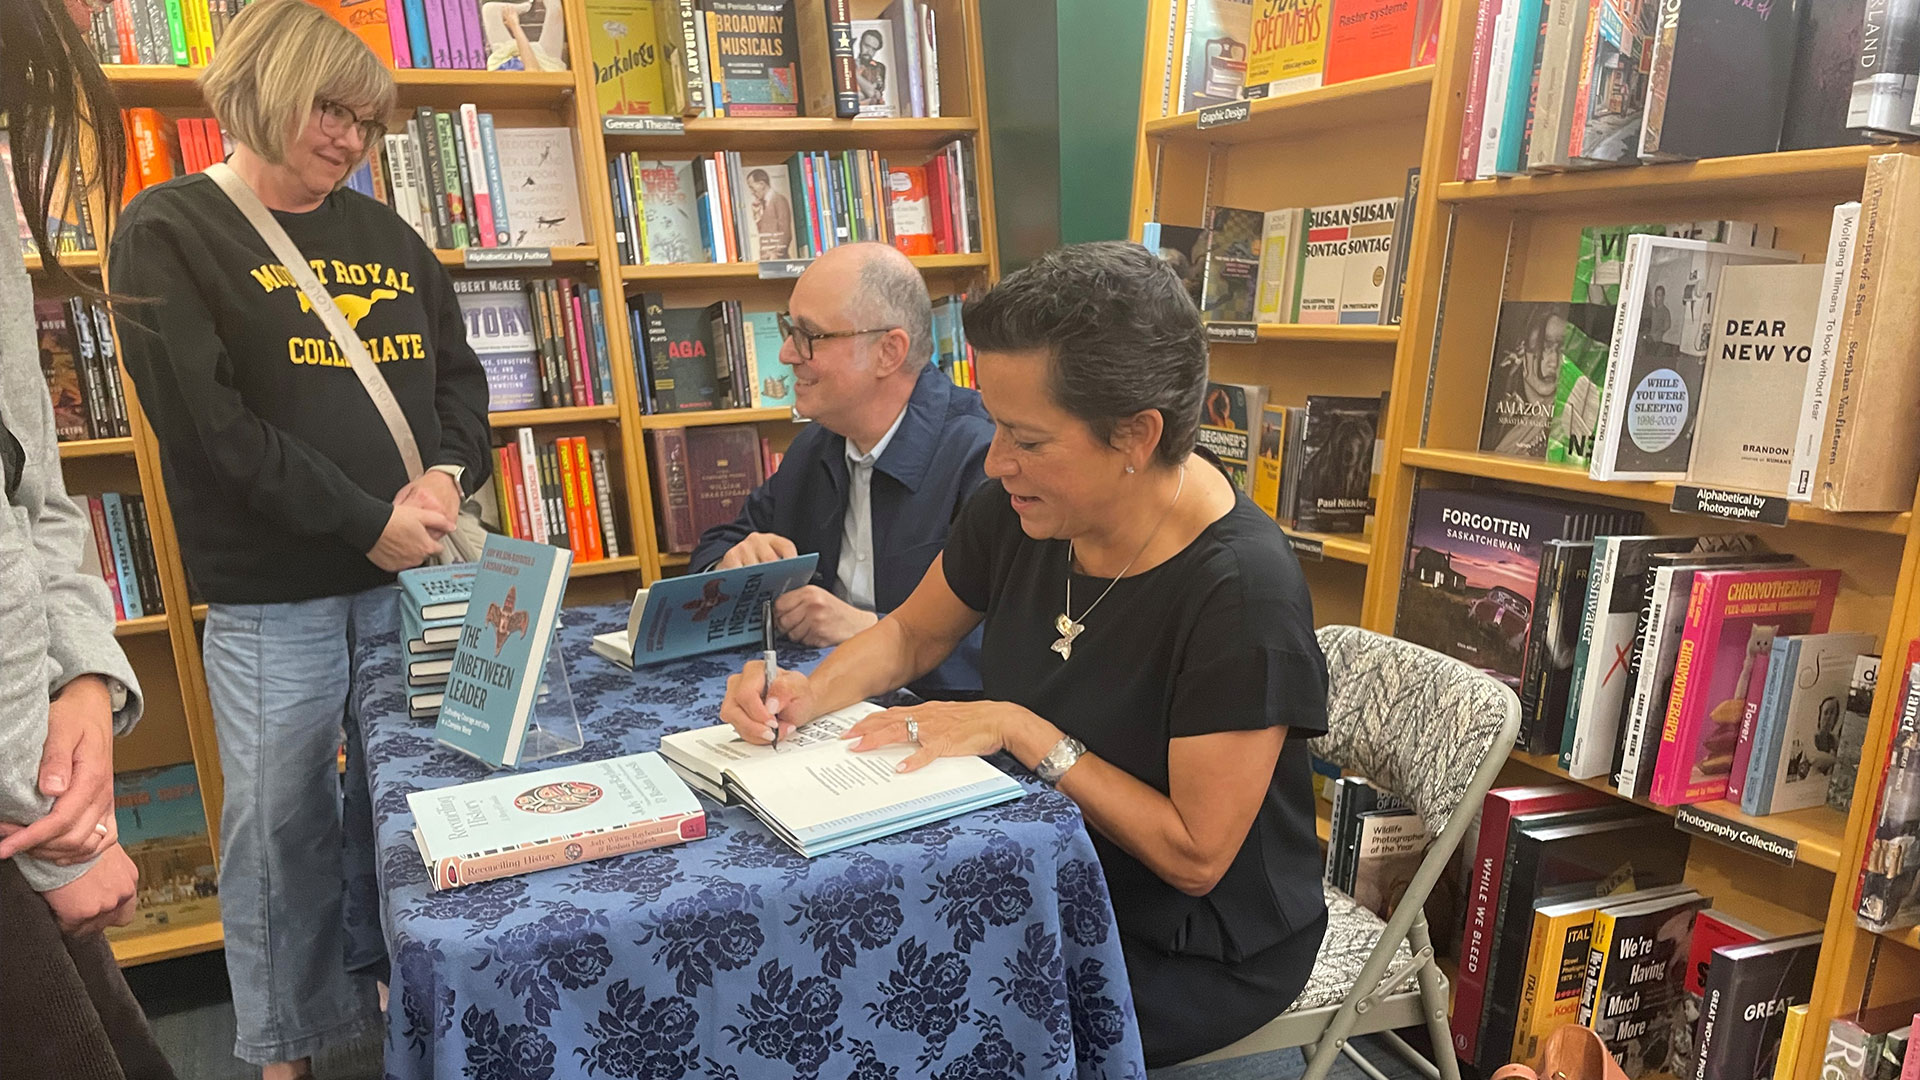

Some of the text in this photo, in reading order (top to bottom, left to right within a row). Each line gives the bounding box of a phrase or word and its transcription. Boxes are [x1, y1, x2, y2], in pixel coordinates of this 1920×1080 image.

[715, 14, 784, 34] BROADWAY
[1338, 13, 1369, 28] Raster
[1664, 0, 1680, 29] ON
[1252, 4, 1323, 55] SPECIMENS
[1860, 0, 1887, 68] RLAND
[683, 21, 699, 74] LIBRARY
[720, 37, 783, 56] MUSICALS
[606, 119, 681, 131] General Theatre
[1201, 106, 1248, 123] Graphic Design
[1309, 208, 1350, 229] SUSAN
[1351, 202, 1397, 224] SUSAN
[1304, 242, 1346, 258] SONTAG
[1347, 237, 1391, 255] SONTAG
[469, 253, 513, 262] Alphabetical
[513, 253, 523, 262] by
[786, 263, 806, 274] Plays
[250, 259, 416, 295] MOUT ROYAL
[453, 281, 486, 293] OBERT
[1855, 294, 1866, 316] Sea
[1725, 319, 1787, 337] DEAR
[1811, 216, 1853, 421] Wolfgang Tillmans To look without fear
[1206, 327, 1236, 339] Photography
[288, 334, 426, 369] COLLIATE
[668, 340, 706, 359] AGA
[1721, 343, 1812, 363] NEW YO
[1599, 301, 1627, 442] WHILE YOU WERE SLEEPING
[1646, 377, 1680, 389] WHILE
[1636, 390, 1686, 401] YOU WERE
[1828, 341, 1859, 465] Stephan Vanfleteren
[1634, 403, 1683, 413] SLEEPING
[1636, 416, 1678, 426] 1998-2000
[1200, 429, 1247, 448] BEGINNER'S
[1742, 443, 1790, 456] BRANDON
[1766, 457, 1792, 465] HUMANS
[1317, 498, 1337, 508] Paul
[1696, 488, 1766, 509] Alphabetical by
[1697, 500, 1760, 519] Photographer
[1442, 508, 1531, 539] FORGOTTEN
[1446, 528, 1521, 553] SASKATCHEWAN
[1575, 569, 1587, 579] FR
[1727, 578, 1822, 601] CHROMOTHERAPIA
[1582, 558, 1604, 645] freshwater
[462, 623, 483, 649] THE
[707, 616, 726, 644] THE
[455, 651, 515, 690] INBETWEEN
[448, 677, 488, 711] LEADER
[1664, 640, 1695, 743] CHROMOTHERAPIA
[1902, 681, 1920, 733] Manet
[1739, 702, 1758, 744] Flower.
[1371, 832, 1426, 845] Photographer
[1373, 824, 1403, 835] Wildlife
[1677, 809, 1795, 860] Photography Collections
[1370, 844, 1414, 854] of the Year
[467, 851, 557, 877] Reconciling History
[1467, 858, 1493, 973] WHILE WE BLEED
[1567, 928, 1592, 944] ITAL
[1619, 936, 1653, 960] We're
[1587, 951, 1603, 977] We're
[1630, 960, 1667, 985] Having
[1525, 974, 1536, 1004] ITALY
[1581, 977, 1598, 1008] Having
[1607, 991, 1640, 1017] Much
[1708, 989, 1720, 1022] GREAT
[1743, 996, 1795, 1022] GREAT
[1616, 1019, 1646, 1042] More
[1611, 1051, 1624, 1066] un
